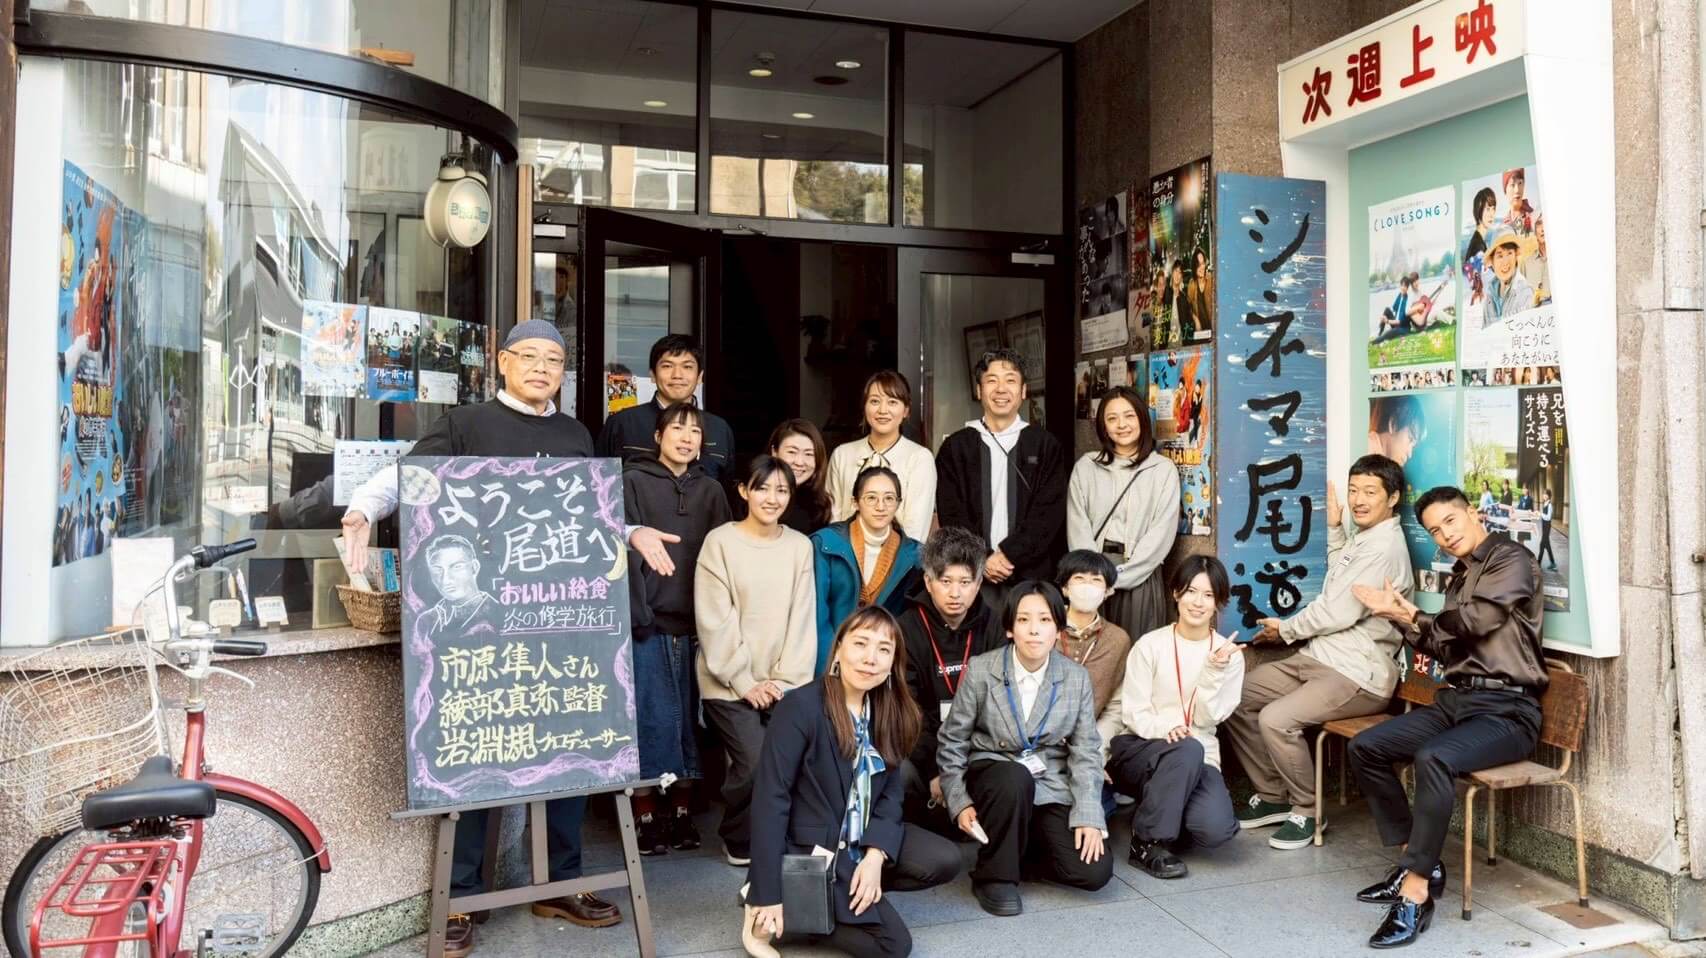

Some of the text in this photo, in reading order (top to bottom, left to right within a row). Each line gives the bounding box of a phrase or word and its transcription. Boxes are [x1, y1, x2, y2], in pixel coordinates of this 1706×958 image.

[1302, 0, 1496, 124] 次週上映
[1511, 334, 1551, 350] 向こうに
[1231, 208, 1313, 628] シネマ尾道
[1524, 394, 1536, 449] サイズに
[1536, 392, 1551, 468] 持ち運べる
[1550, 393, 1566, 426] 兄を
[438, 474, 587, 528] ようこそ
[498, 516, 617, 574] 尾道へ
[492, 576, 611, 605] 「おいしい給食
[439, 641, 600, 689] 市原隼人さん
[938, 664, 970, 675] Suprem
[438, 680, 609, 729] 綾部真弥監督
